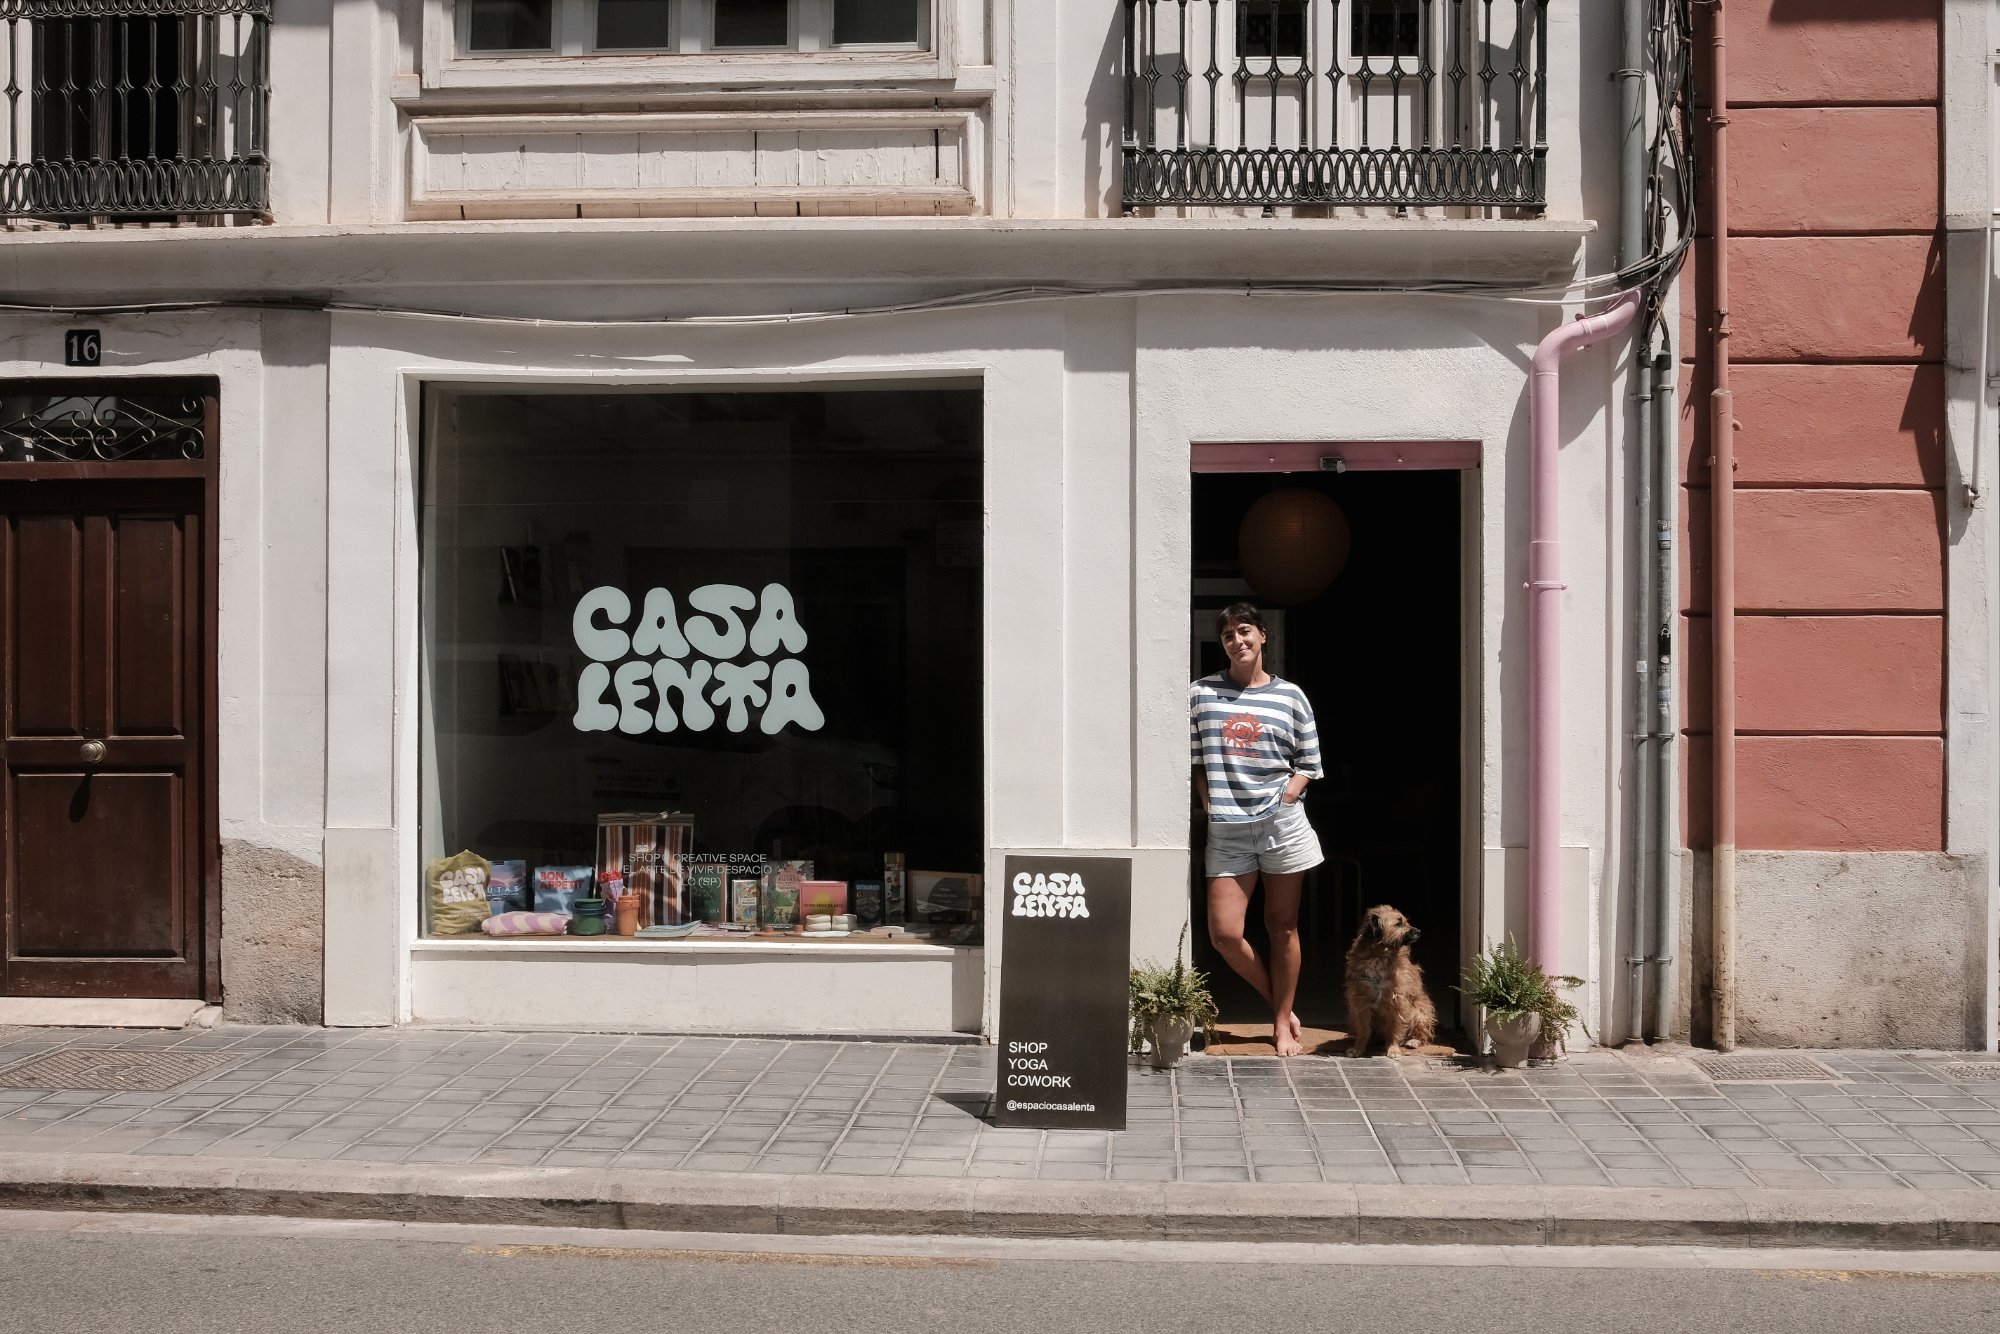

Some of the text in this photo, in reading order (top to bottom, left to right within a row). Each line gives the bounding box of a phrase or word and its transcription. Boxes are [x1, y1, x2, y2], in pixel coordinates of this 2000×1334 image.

[70, 335, 97, 361] 16
[572, 582, 808, 662] CASA
[572, 658, 825, 735] LENTA
[629, 853, 661, 863] SHOP
[672, 853, 727, 863] CREATIVE
[729, 853, 767, 863] SPACE
[623, 865, 637, 874] EL
[638, 865, 667, 874] ARTE
[686, 865, 714, 875] VIVIR
[716, 865, 773, 875] DESPACIO
[1013, 872, 1086, 896] CASA
[1011, 894, 1090, 919] LENTA
[1008, 1041, 1048, 1054] SHOP
[1007, 1058, 1049, 1071] YOGA
[1007, 1074, 1072, 1088] COWORK
[1006, 1099, 1095, 1112] @espaciocasalenta
